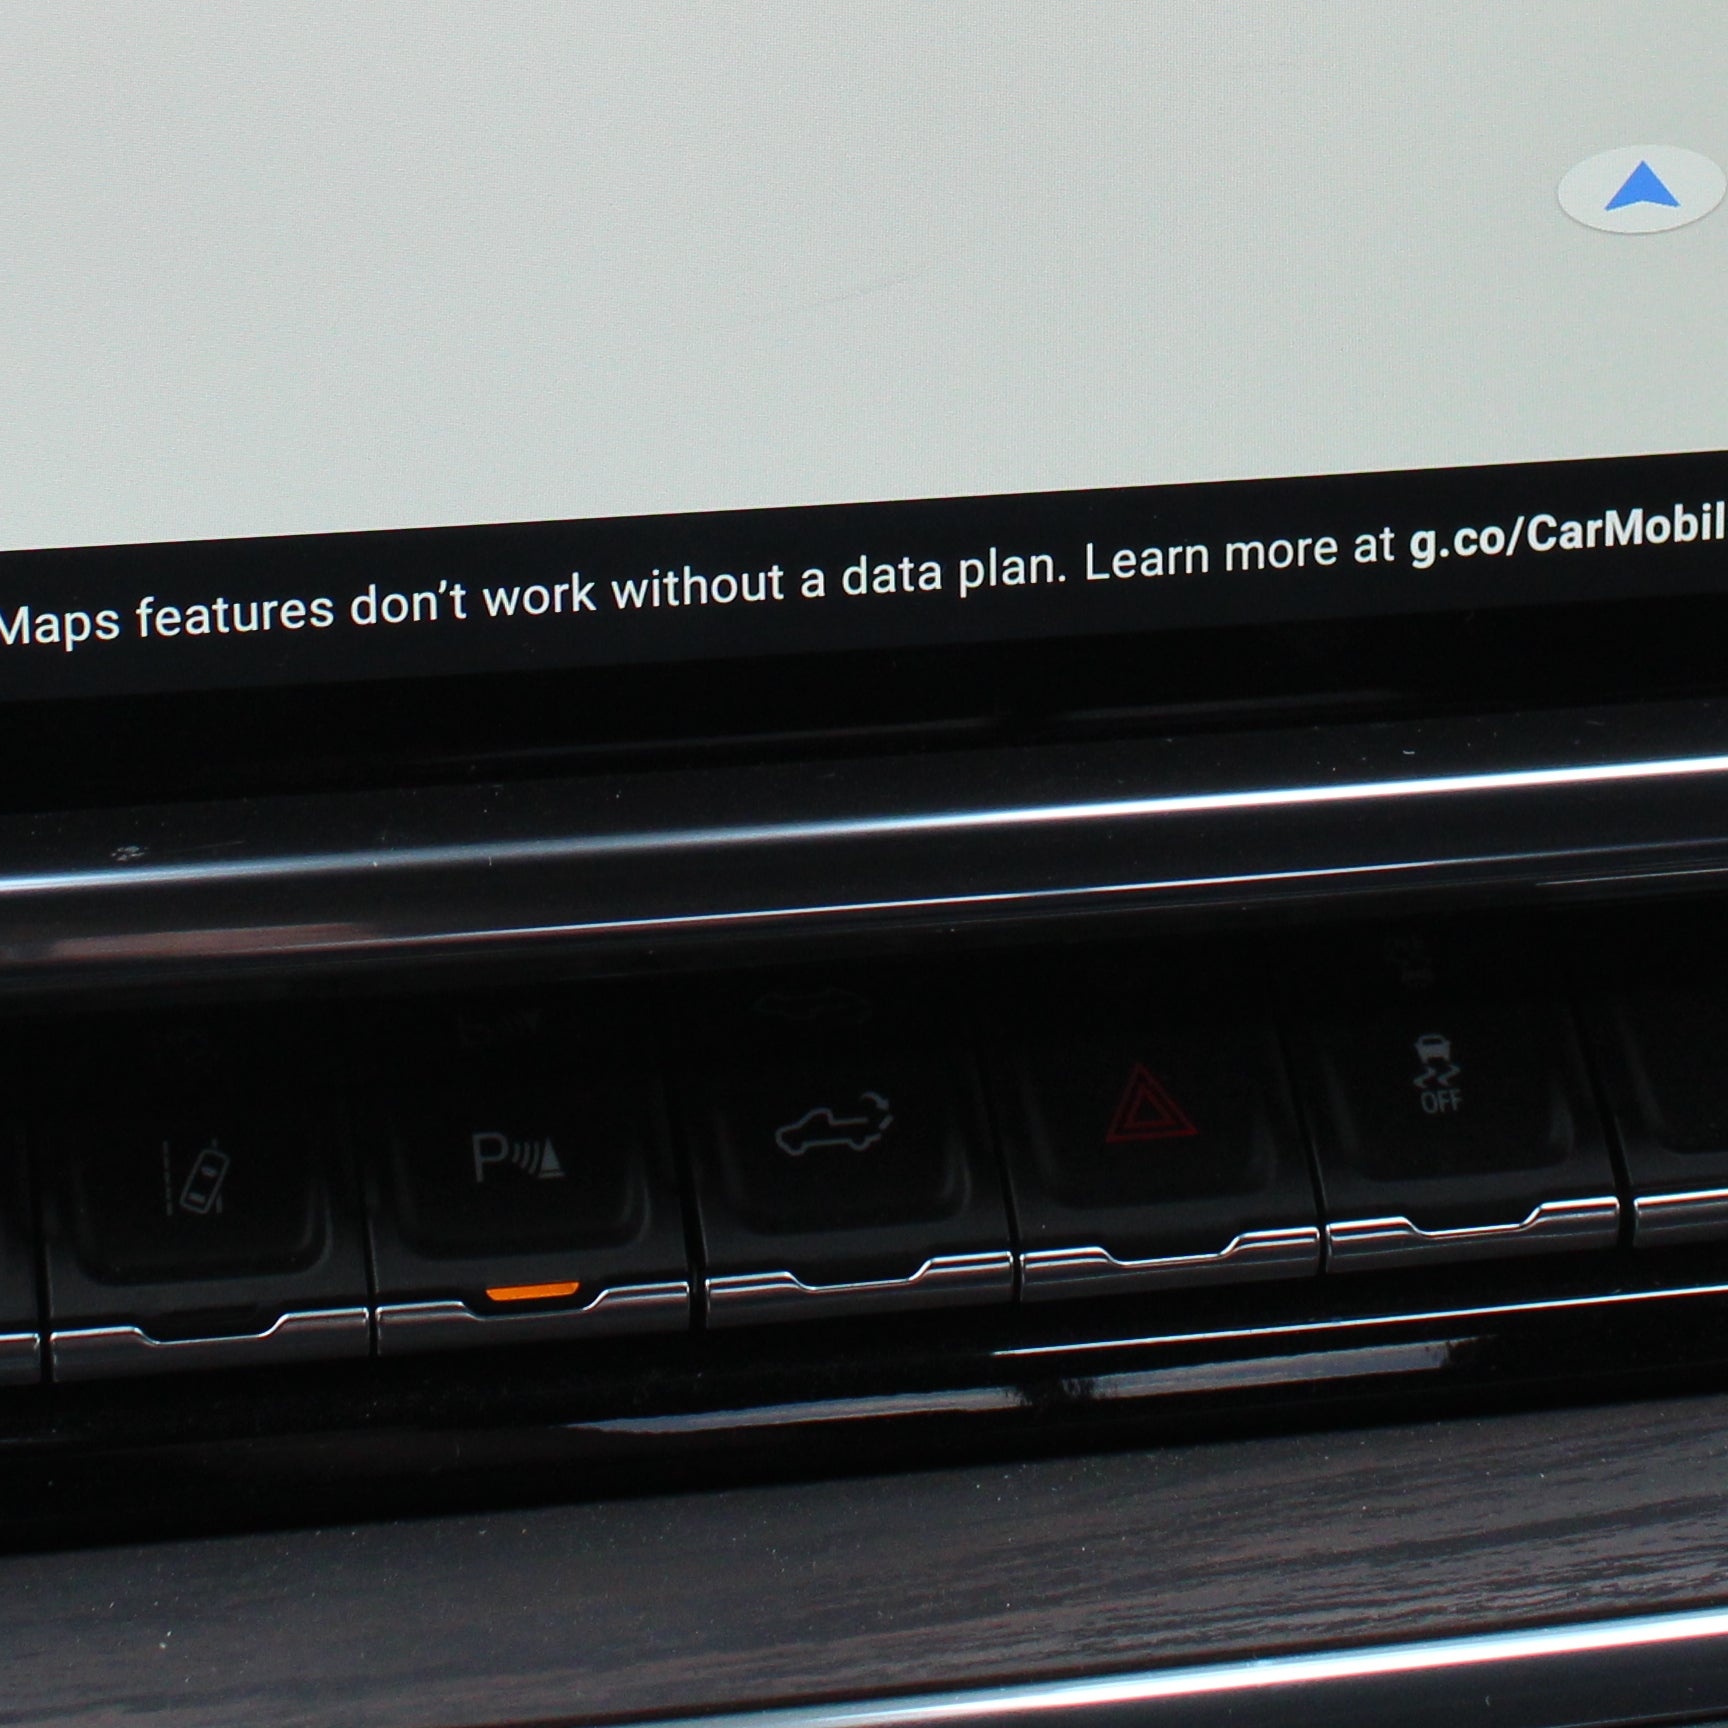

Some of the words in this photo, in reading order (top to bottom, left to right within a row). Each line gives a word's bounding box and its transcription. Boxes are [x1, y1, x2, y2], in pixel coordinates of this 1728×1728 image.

[135, 595, 334, 638] features
[350, 579, 467, 626] don’t
[482, 571, 597, 617] work
[610, 564, 785, 610] without
[801, 568, 826, 598] a
[842, 554, 943, 596] data
[959, 546, 1066, 599] plan.
[1086, 542, 1209, 581] Learn
[1225, 536, 1338, 572] more
[1354, 526, 1395, 564] at
[1419, 1087, 1464, 1115] OFF
